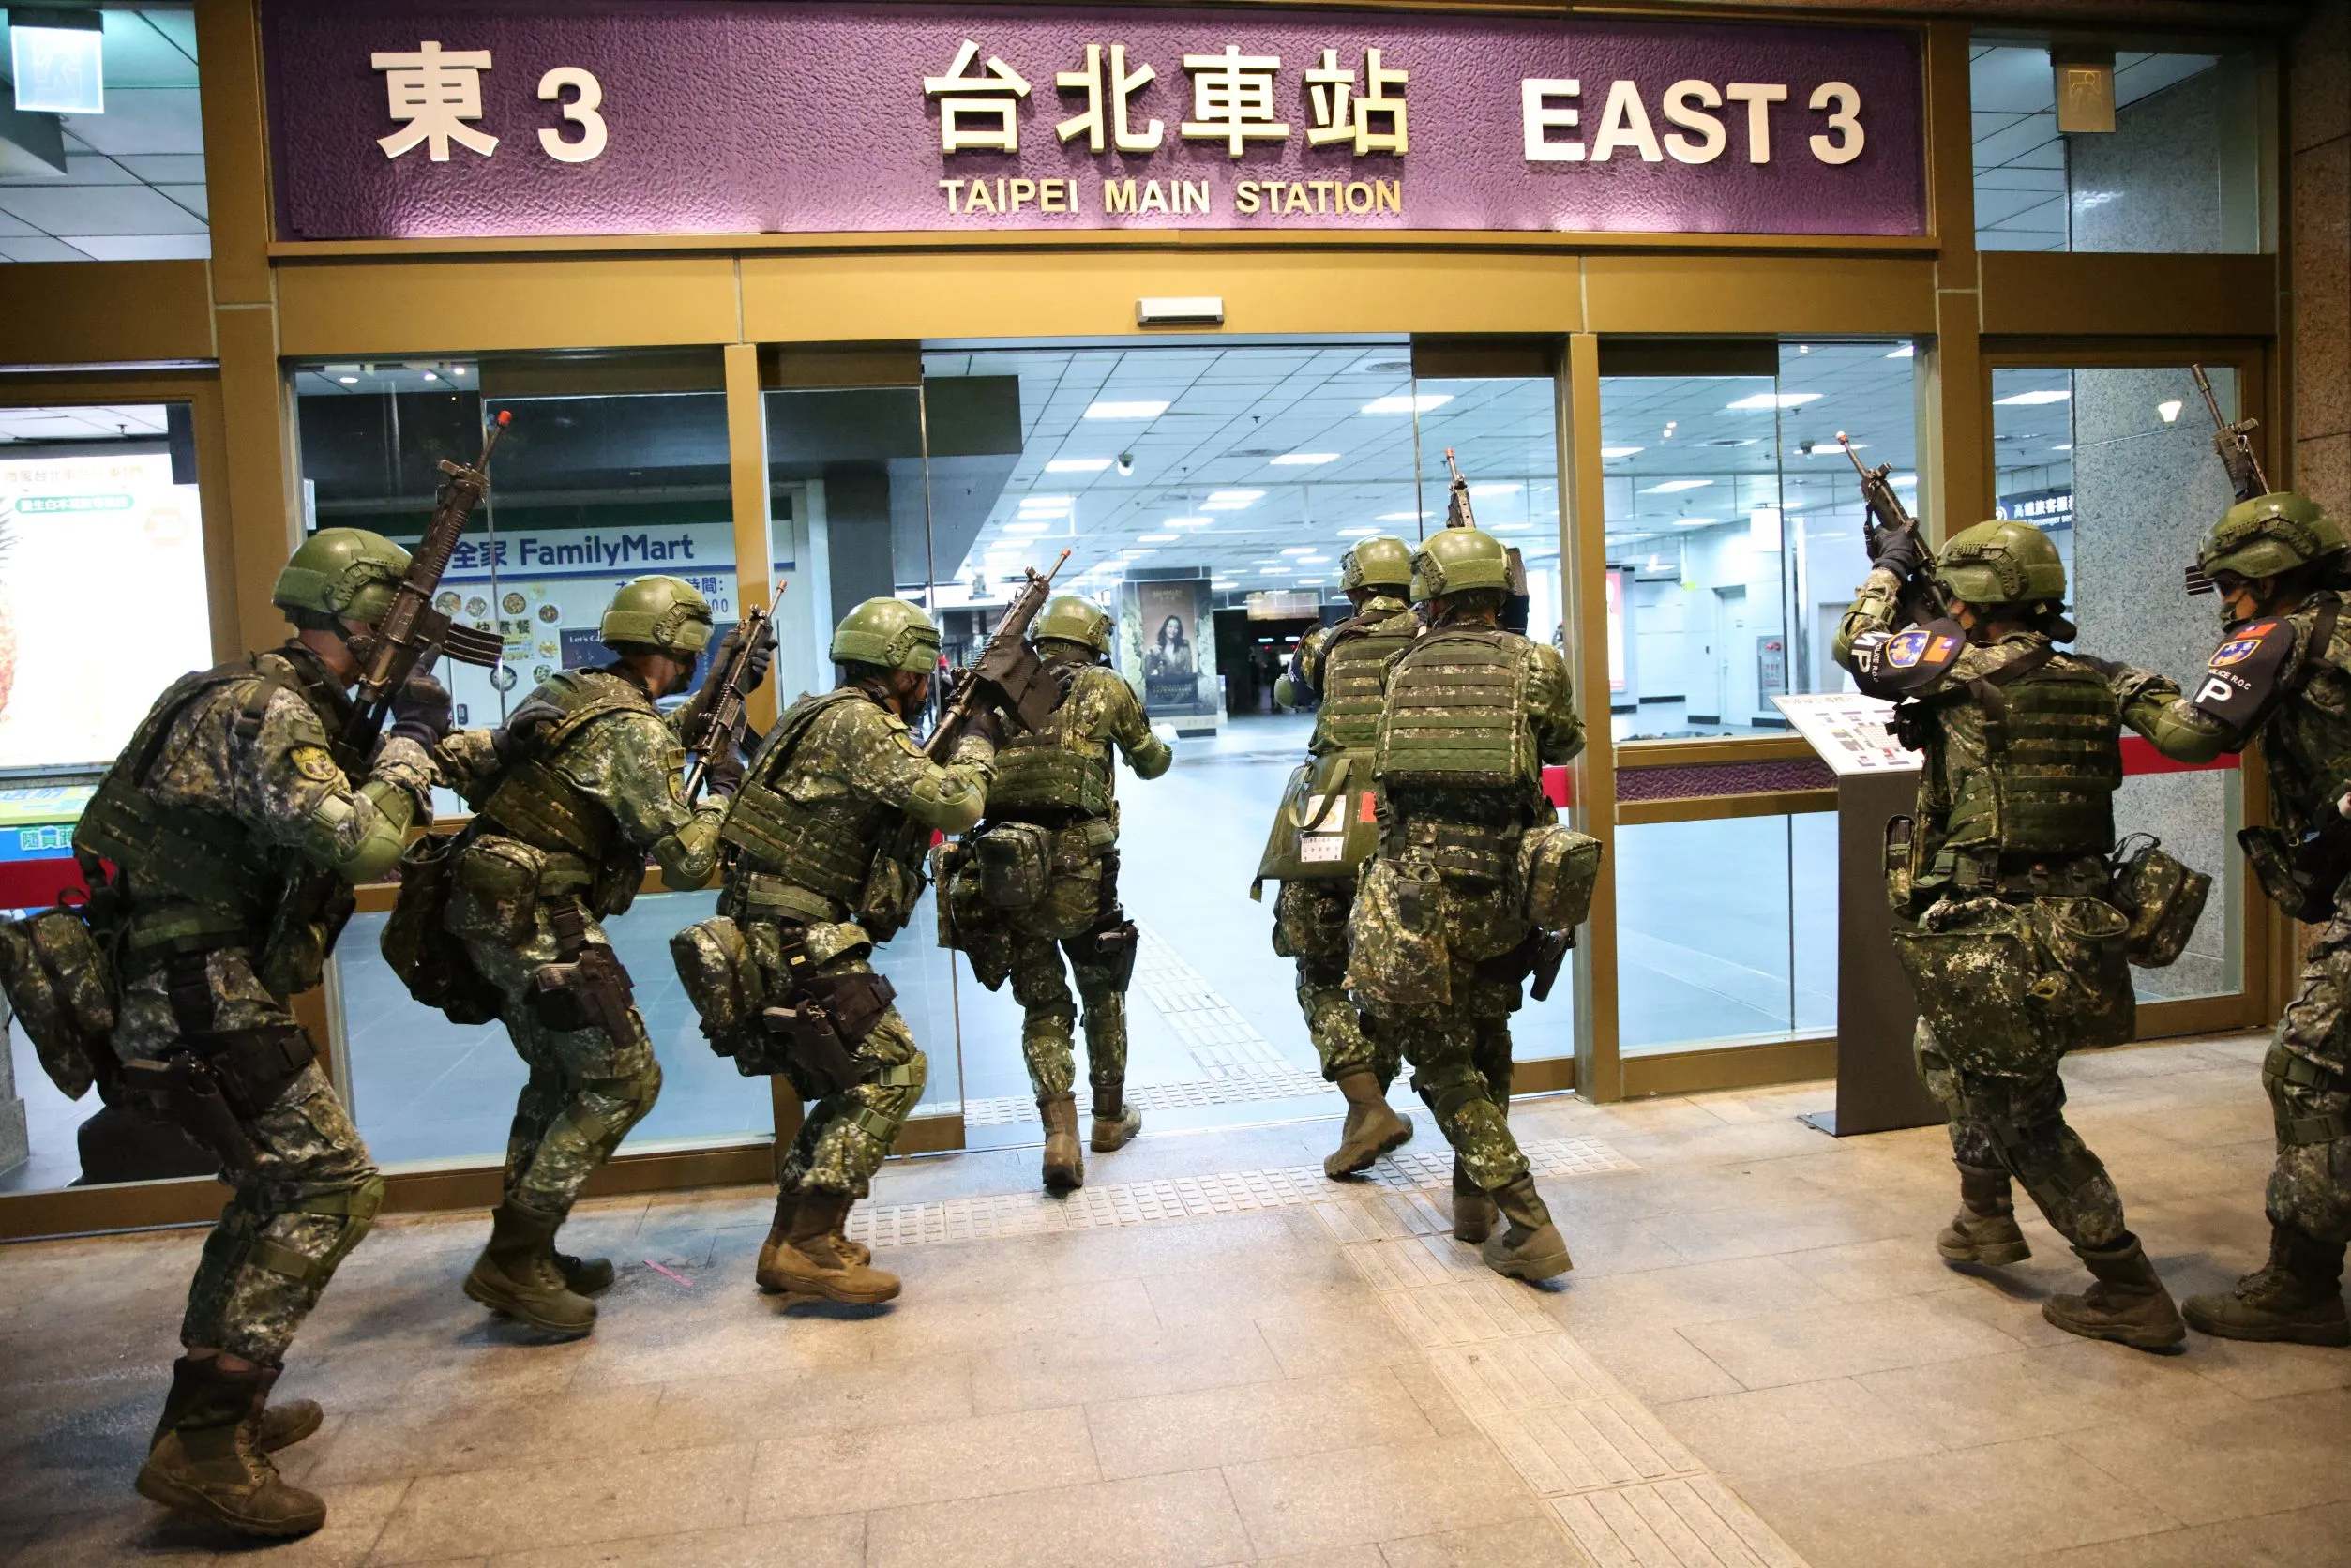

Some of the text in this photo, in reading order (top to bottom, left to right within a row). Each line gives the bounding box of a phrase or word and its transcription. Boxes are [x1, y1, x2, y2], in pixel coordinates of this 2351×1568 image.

[370, 40, 609, 163] 東 3
[923, 38, 1409, 158] 台北車站
[1521, 78, 1865, 165] EAST 3
[940, 178, 1402, 214] TAIPEI MAIN STATION
[451, 534, 695, 570] 全家 FamilyMart
[1851, 630, 1894, 673] MP
[2208, 668, 2231, 679] OLICE
